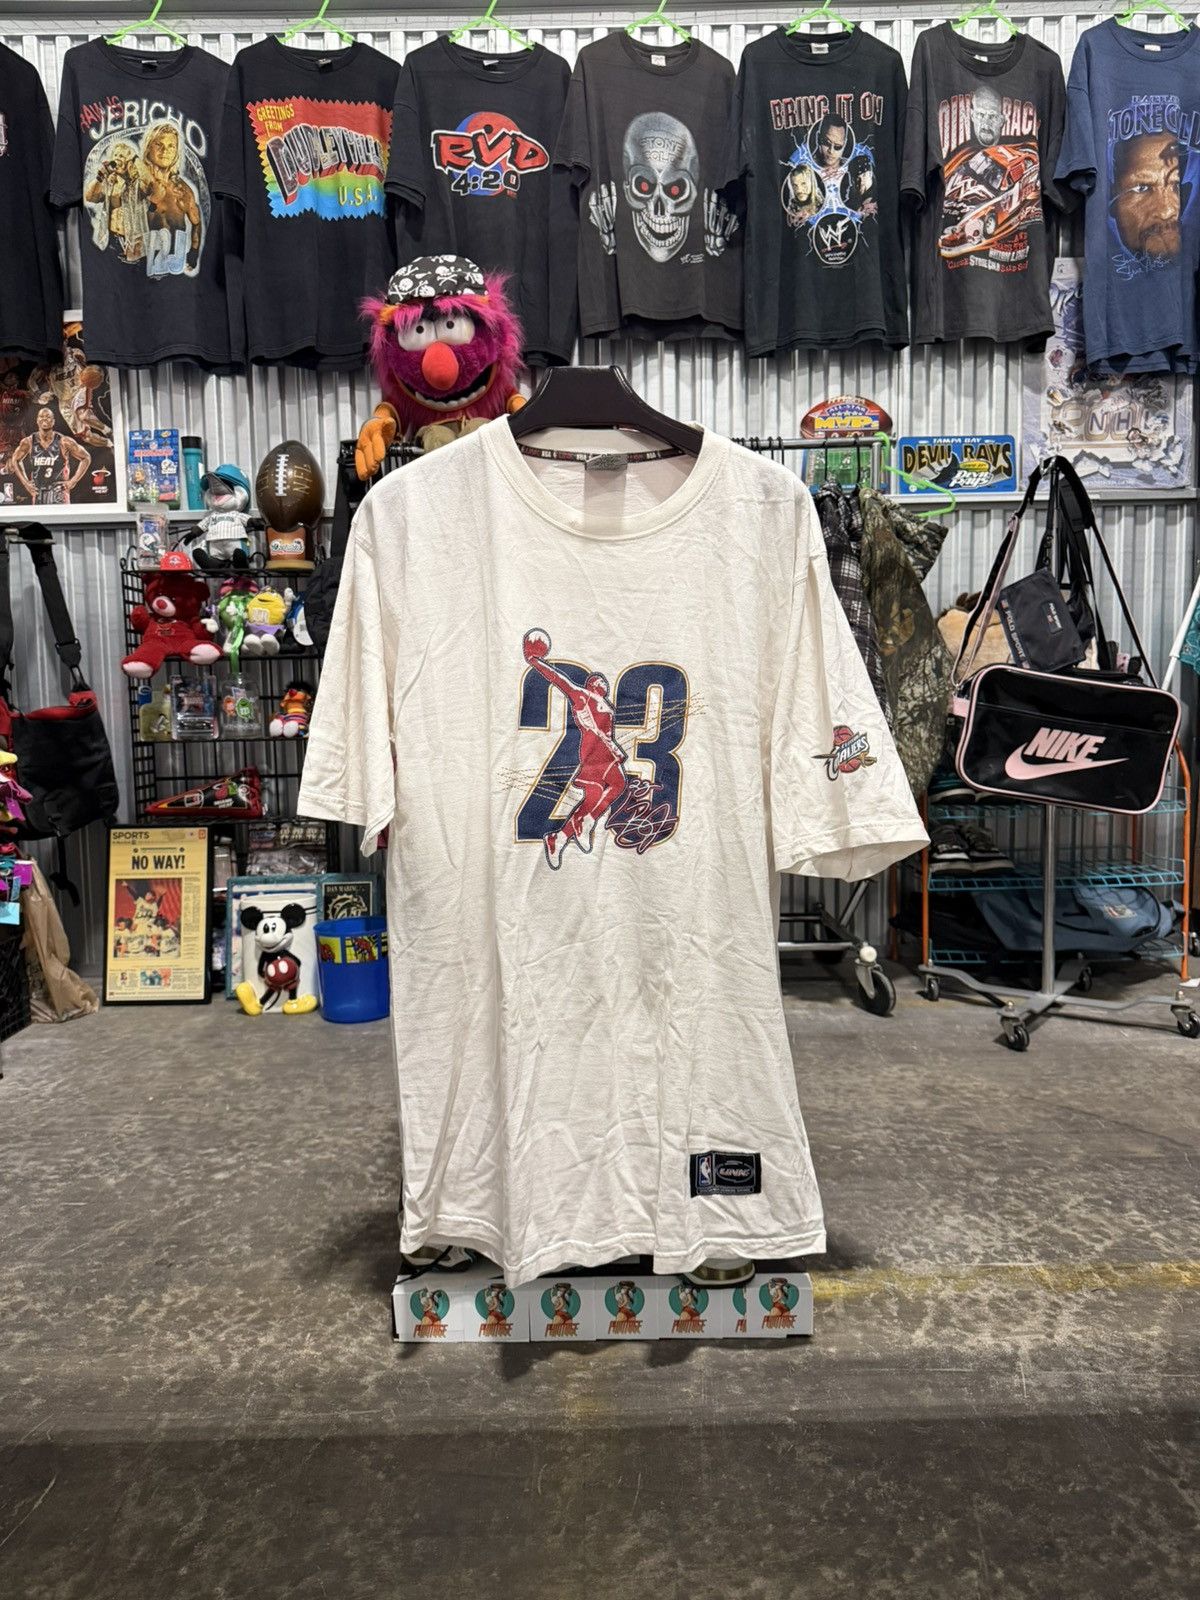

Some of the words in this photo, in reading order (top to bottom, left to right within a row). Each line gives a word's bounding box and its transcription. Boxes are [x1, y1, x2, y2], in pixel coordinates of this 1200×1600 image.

[89, 99, 207, 157] JERICHO
[256, 103, 295, 121] GREETINGS
[264, 120, 284, 137] FROM
[770, 94, 830, 131] BRING
[836, 93, 854, 125] IT
[431, 128, 550, 174] RVD
[451, 169, 520, 196] 4:20
[44, 467, 53, 478] 3
[963, 442, 1014, 478] RAYS
[1005, 610, 1016, 632] POLO
[1011, 632, 1027, 658] SPORT
[514, 658, 691, 846] 23
[1024, 727, 1106, 763] NIKE
[112, 831, 150, 840] SPORTS
[131, 855, 149, 870] NO
[153, 854, 186, 870] WAY!
